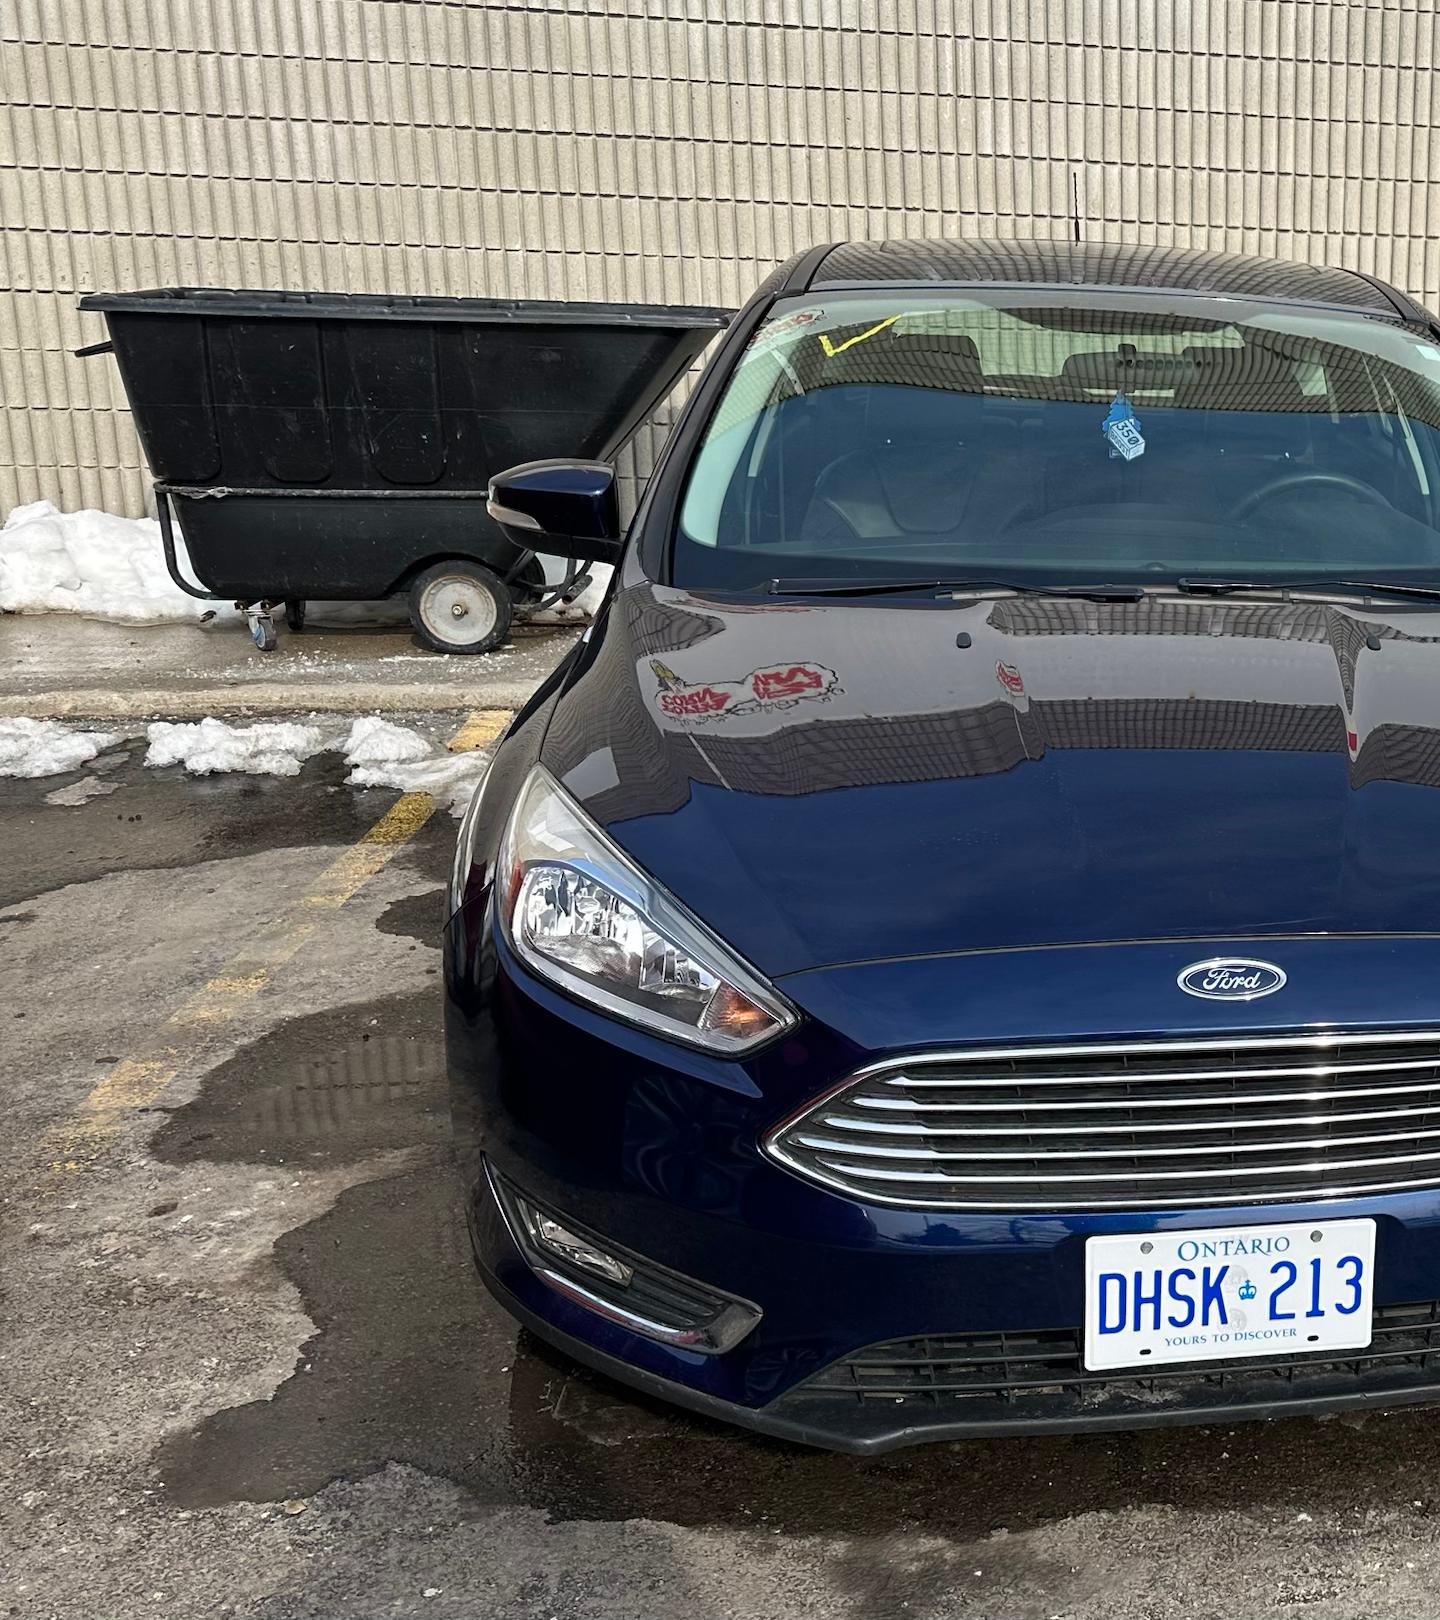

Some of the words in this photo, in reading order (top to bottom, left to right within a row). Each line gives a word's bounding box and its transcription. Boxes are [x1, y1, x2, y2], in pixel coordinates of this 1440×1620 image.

[1116, 421, 1139, 445] 350
[1202, 967, 1261, 990] Ford
[1177, 1236, 1290, 1261] ONTARIO
[1099, 1265, 1230, 1335] DHSK
[1269, 1255, 1364, 1321] 213
[1164, 1335, 1207, 1347] YOURS
[1213, 1333, 1230, 1343] TO
[1234, 1328, 1297, 1341] DISCOVER
